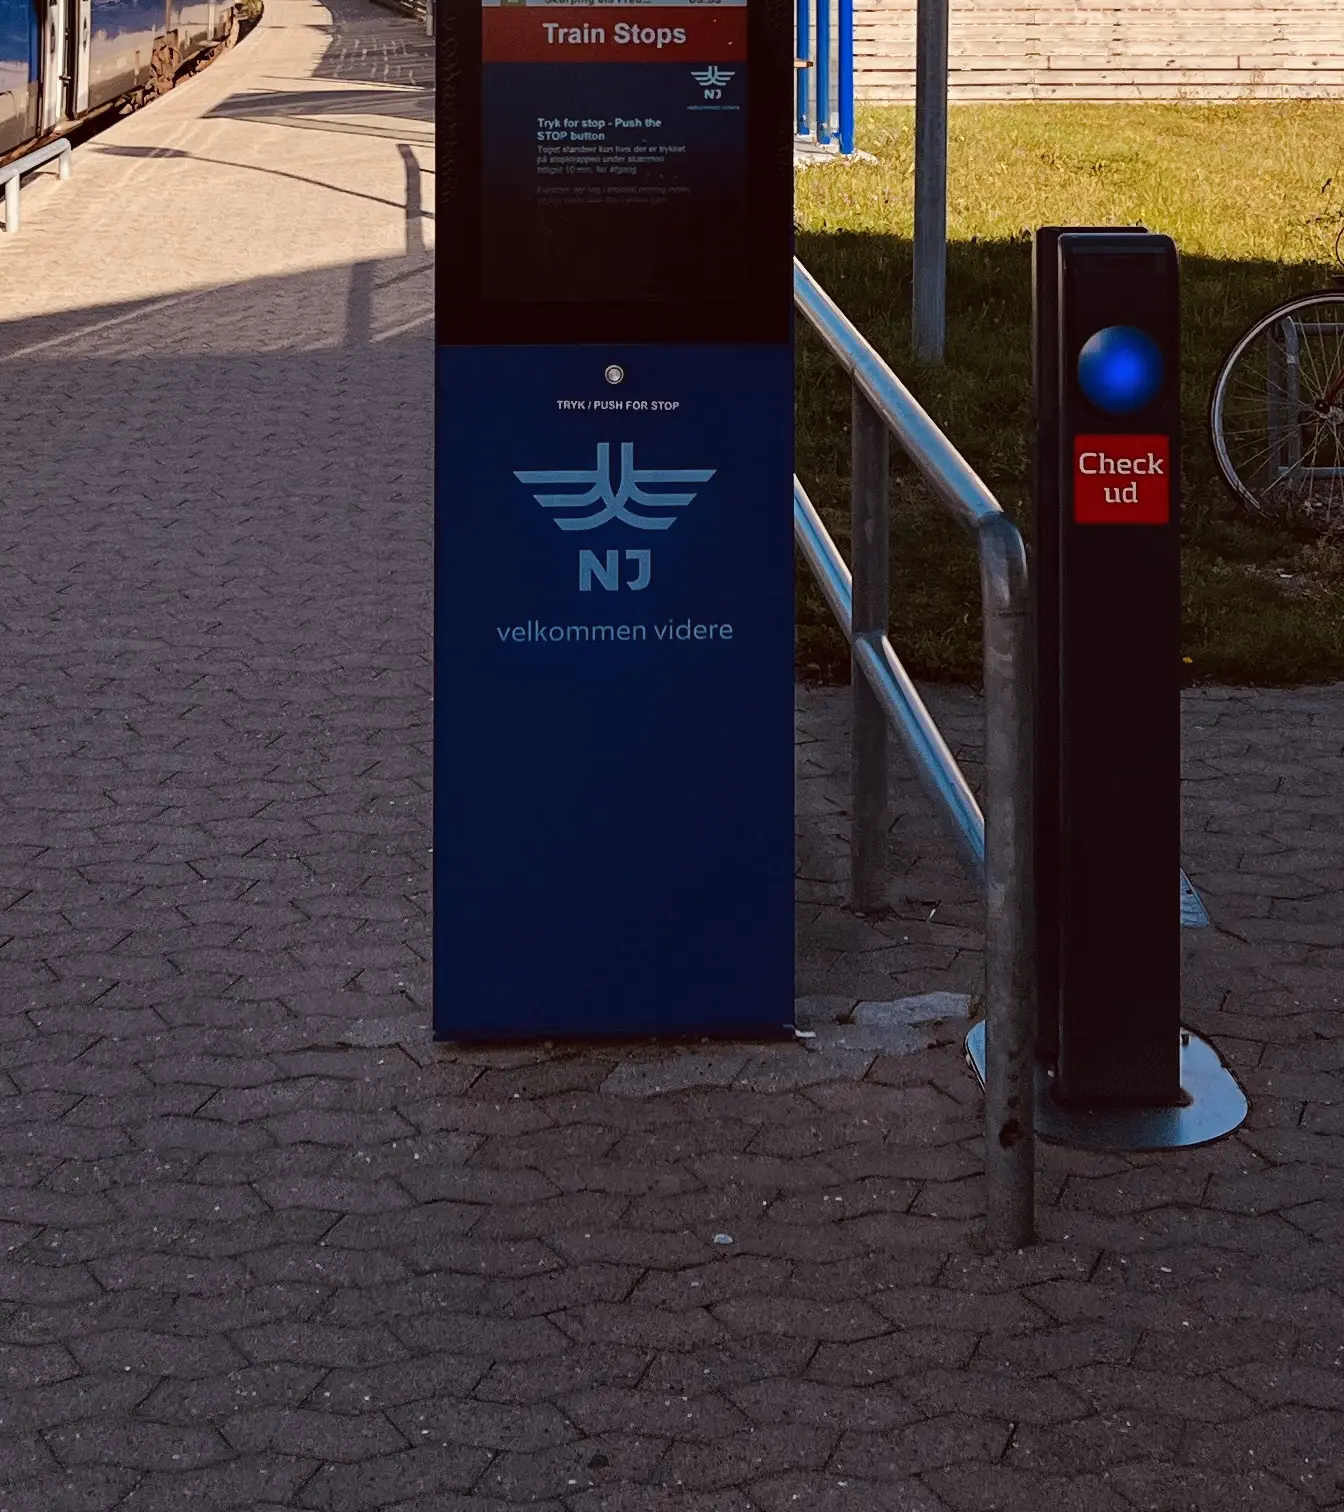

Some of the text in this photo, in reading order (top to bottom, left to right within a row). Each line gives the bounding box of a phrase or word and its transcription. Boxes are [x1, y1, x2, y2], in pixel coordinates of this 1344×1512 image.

[542, 22, 687, 49] Train Stops
[703, 89, 722, 100] NJ
[537, 117, 561, 130] Tryk
[563, 117, 579, 128] for
[581, 117, 606, 130] stop
[614, 117, 643, 128] Push
[644, 117, 662, 128] the
[536, 131, 606, 141] STOP button
[556, 400, 586, 411] TRYK
[593, 400, 623, 411] PUSH
[625, 400, 649, 412] FOR
[650, 401, 680, 412] STOP
[1078, 452, 1164, 475] Check
[1103, 481, 1139, 504] ud
[578, 549, 652, 592] NJ
[496, 618, 734, 643] velkommen videre
